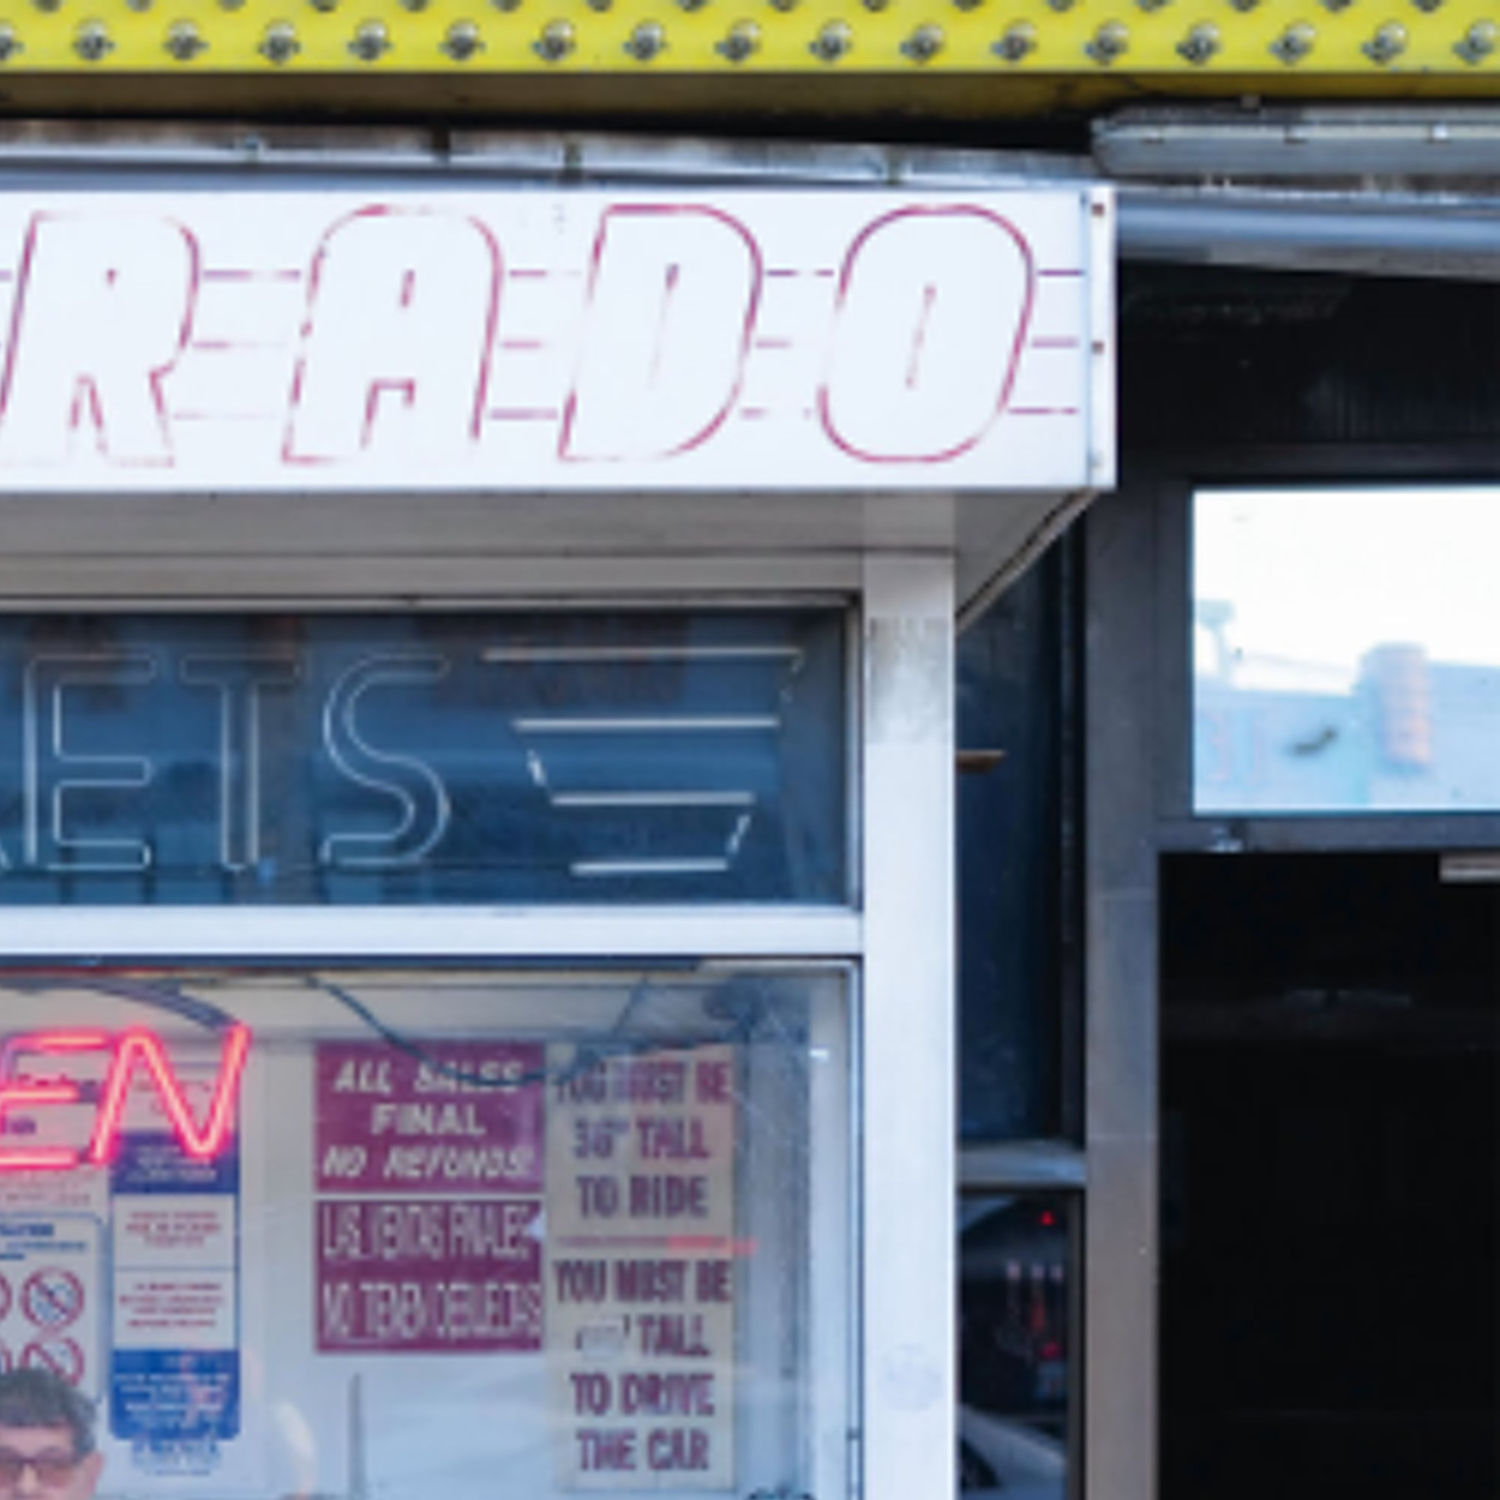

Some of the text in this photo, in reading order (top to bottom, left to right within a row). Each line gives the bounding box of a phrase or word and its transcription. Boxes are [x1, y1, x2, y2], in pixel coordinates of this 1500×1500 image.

[332, 1059, 392, 1094] ALL
[371, 1103, 487, 1135] FINAL
[636, 1116, 712, 1159] TALL
[322, 1145, 368, 1178] NO
[574, 1174, 710, 1220] TO RIDE
[551, 1258, 733, 1303] YOU MUST BE
[636, 1315, 713, 1358] TALL
[570, 1371, 715, 1416] TO DRIVE
[575, 1427, 711, 1472] THE CAR
